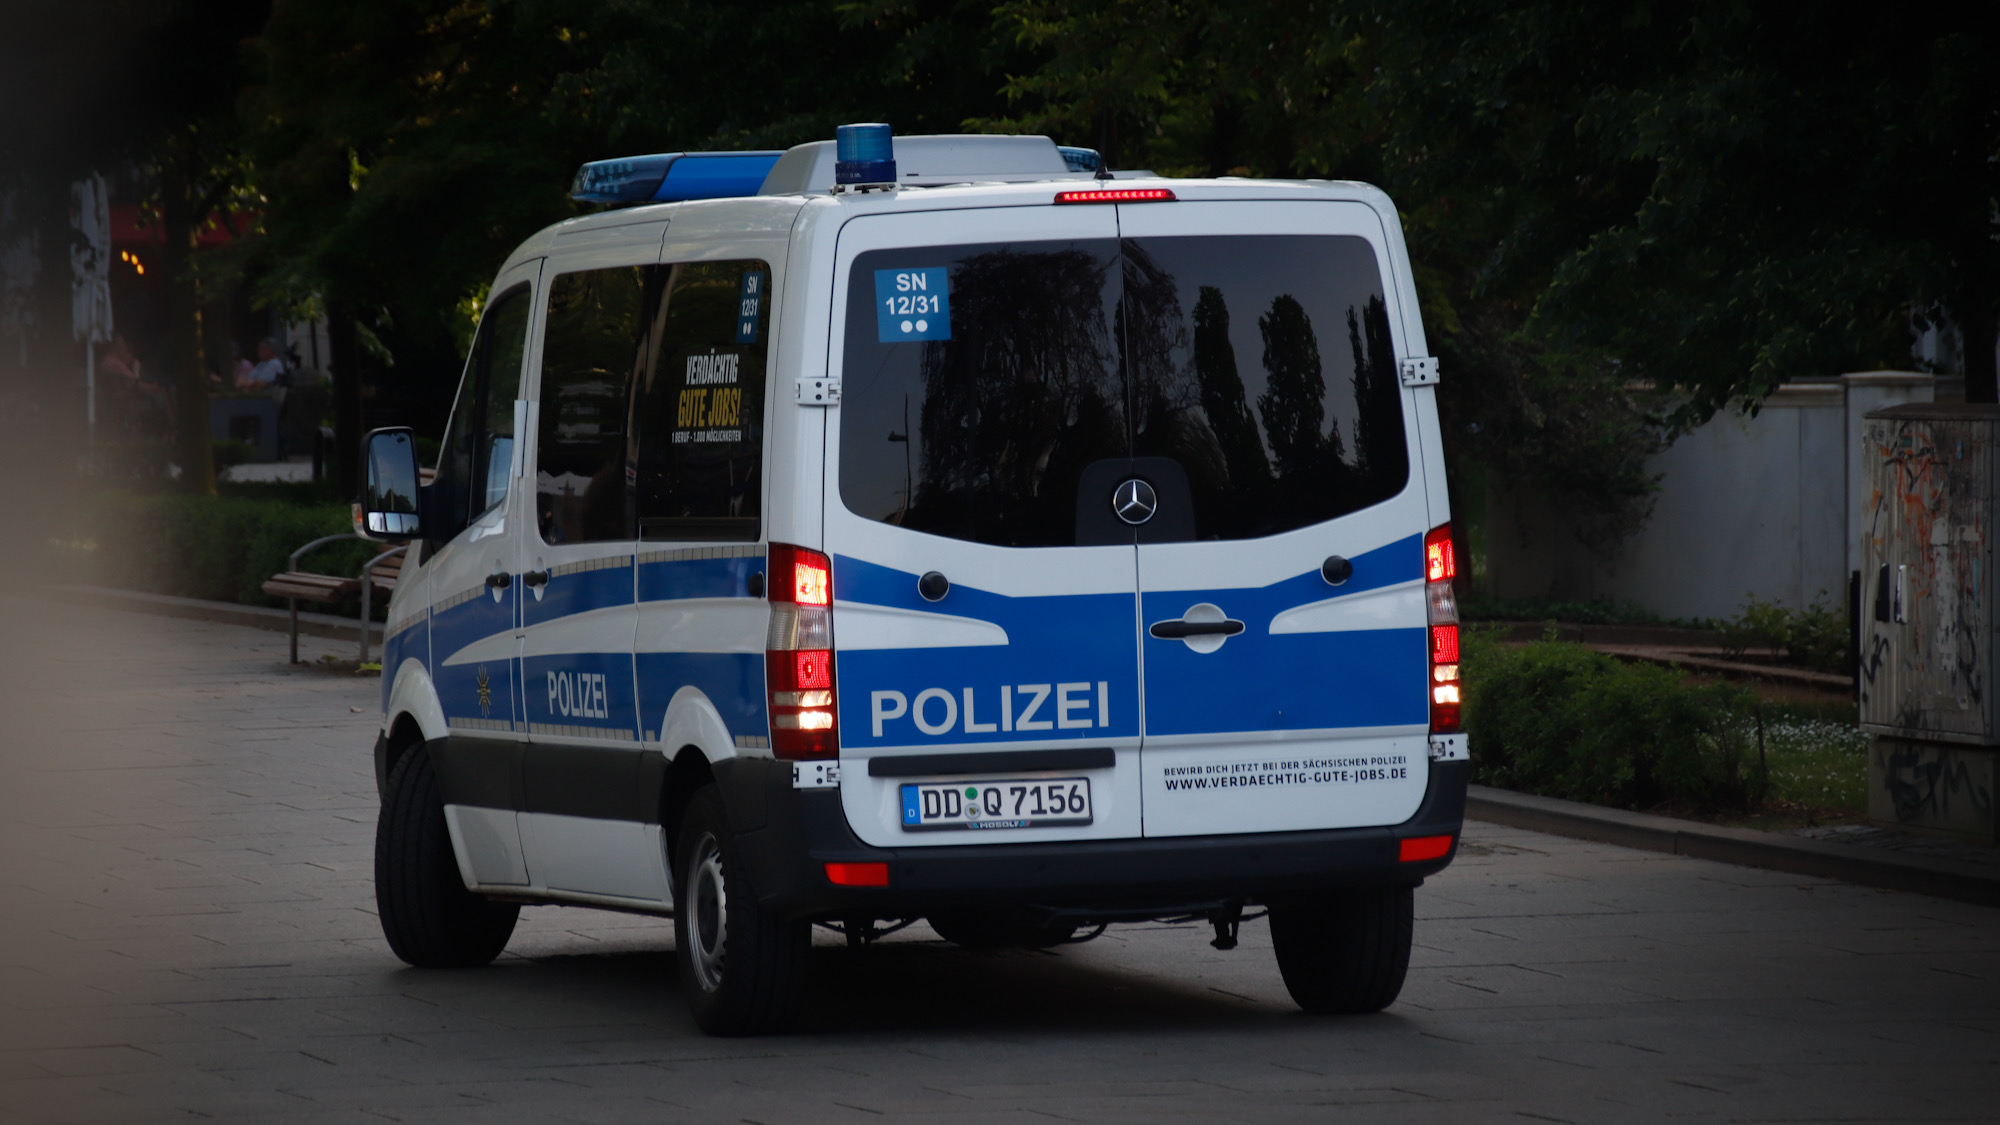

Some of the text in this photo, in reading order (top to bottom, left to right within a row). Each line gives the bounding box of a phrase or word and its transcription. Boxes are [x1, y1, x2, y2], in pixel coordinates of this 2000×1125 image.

[747, 276, 758, 294] SN
[896, 272, 927, 292] SN
[885, 294, 939, 316] 12/31
[686, 348, 739, 385] VERDÄCHTIG
[677, 387, 742, 428] GUTE JOBS!
[546, 670, 609, 719] POLIZEI
[871, 681, 1109, 737] POLIZEI
[1164, 755, 1407, 776] BEWIRB DICH JETZT BEI DER SÄCHSISCHEN POLIZEI
[1165, 768, 1407, 791] WWW.VERDAECHTIG-GUTE-JOBS.DE
[922, 784, 1085, 818] DD Q 7156
[908, 808, 916, 818] D
